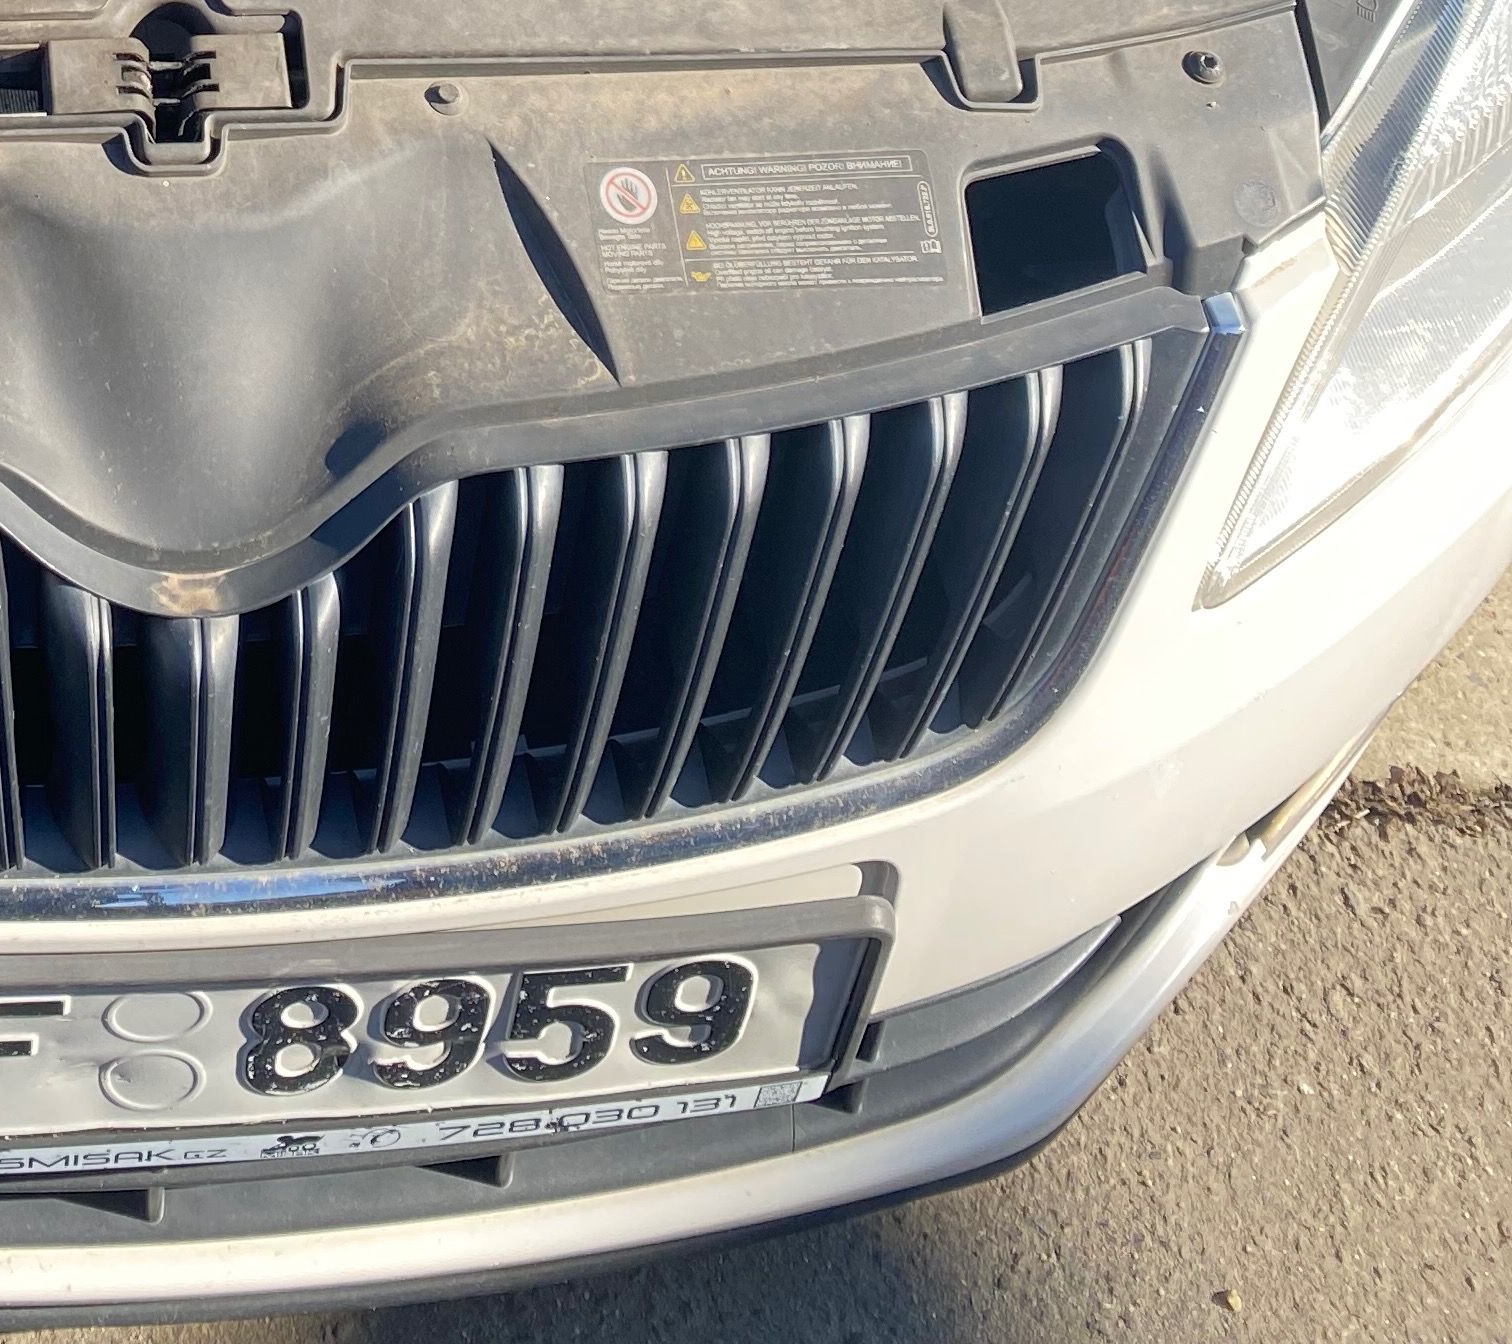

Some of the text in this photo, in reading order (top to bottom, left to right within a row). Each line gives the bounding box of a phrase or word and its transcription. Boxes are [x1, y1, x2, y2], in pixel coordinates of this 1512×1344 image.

[708, 164, 757, 176] ACHTUNG!
[759, 162, 807, 174] WARNING!
[237, 957, 759, 1097] 8959
